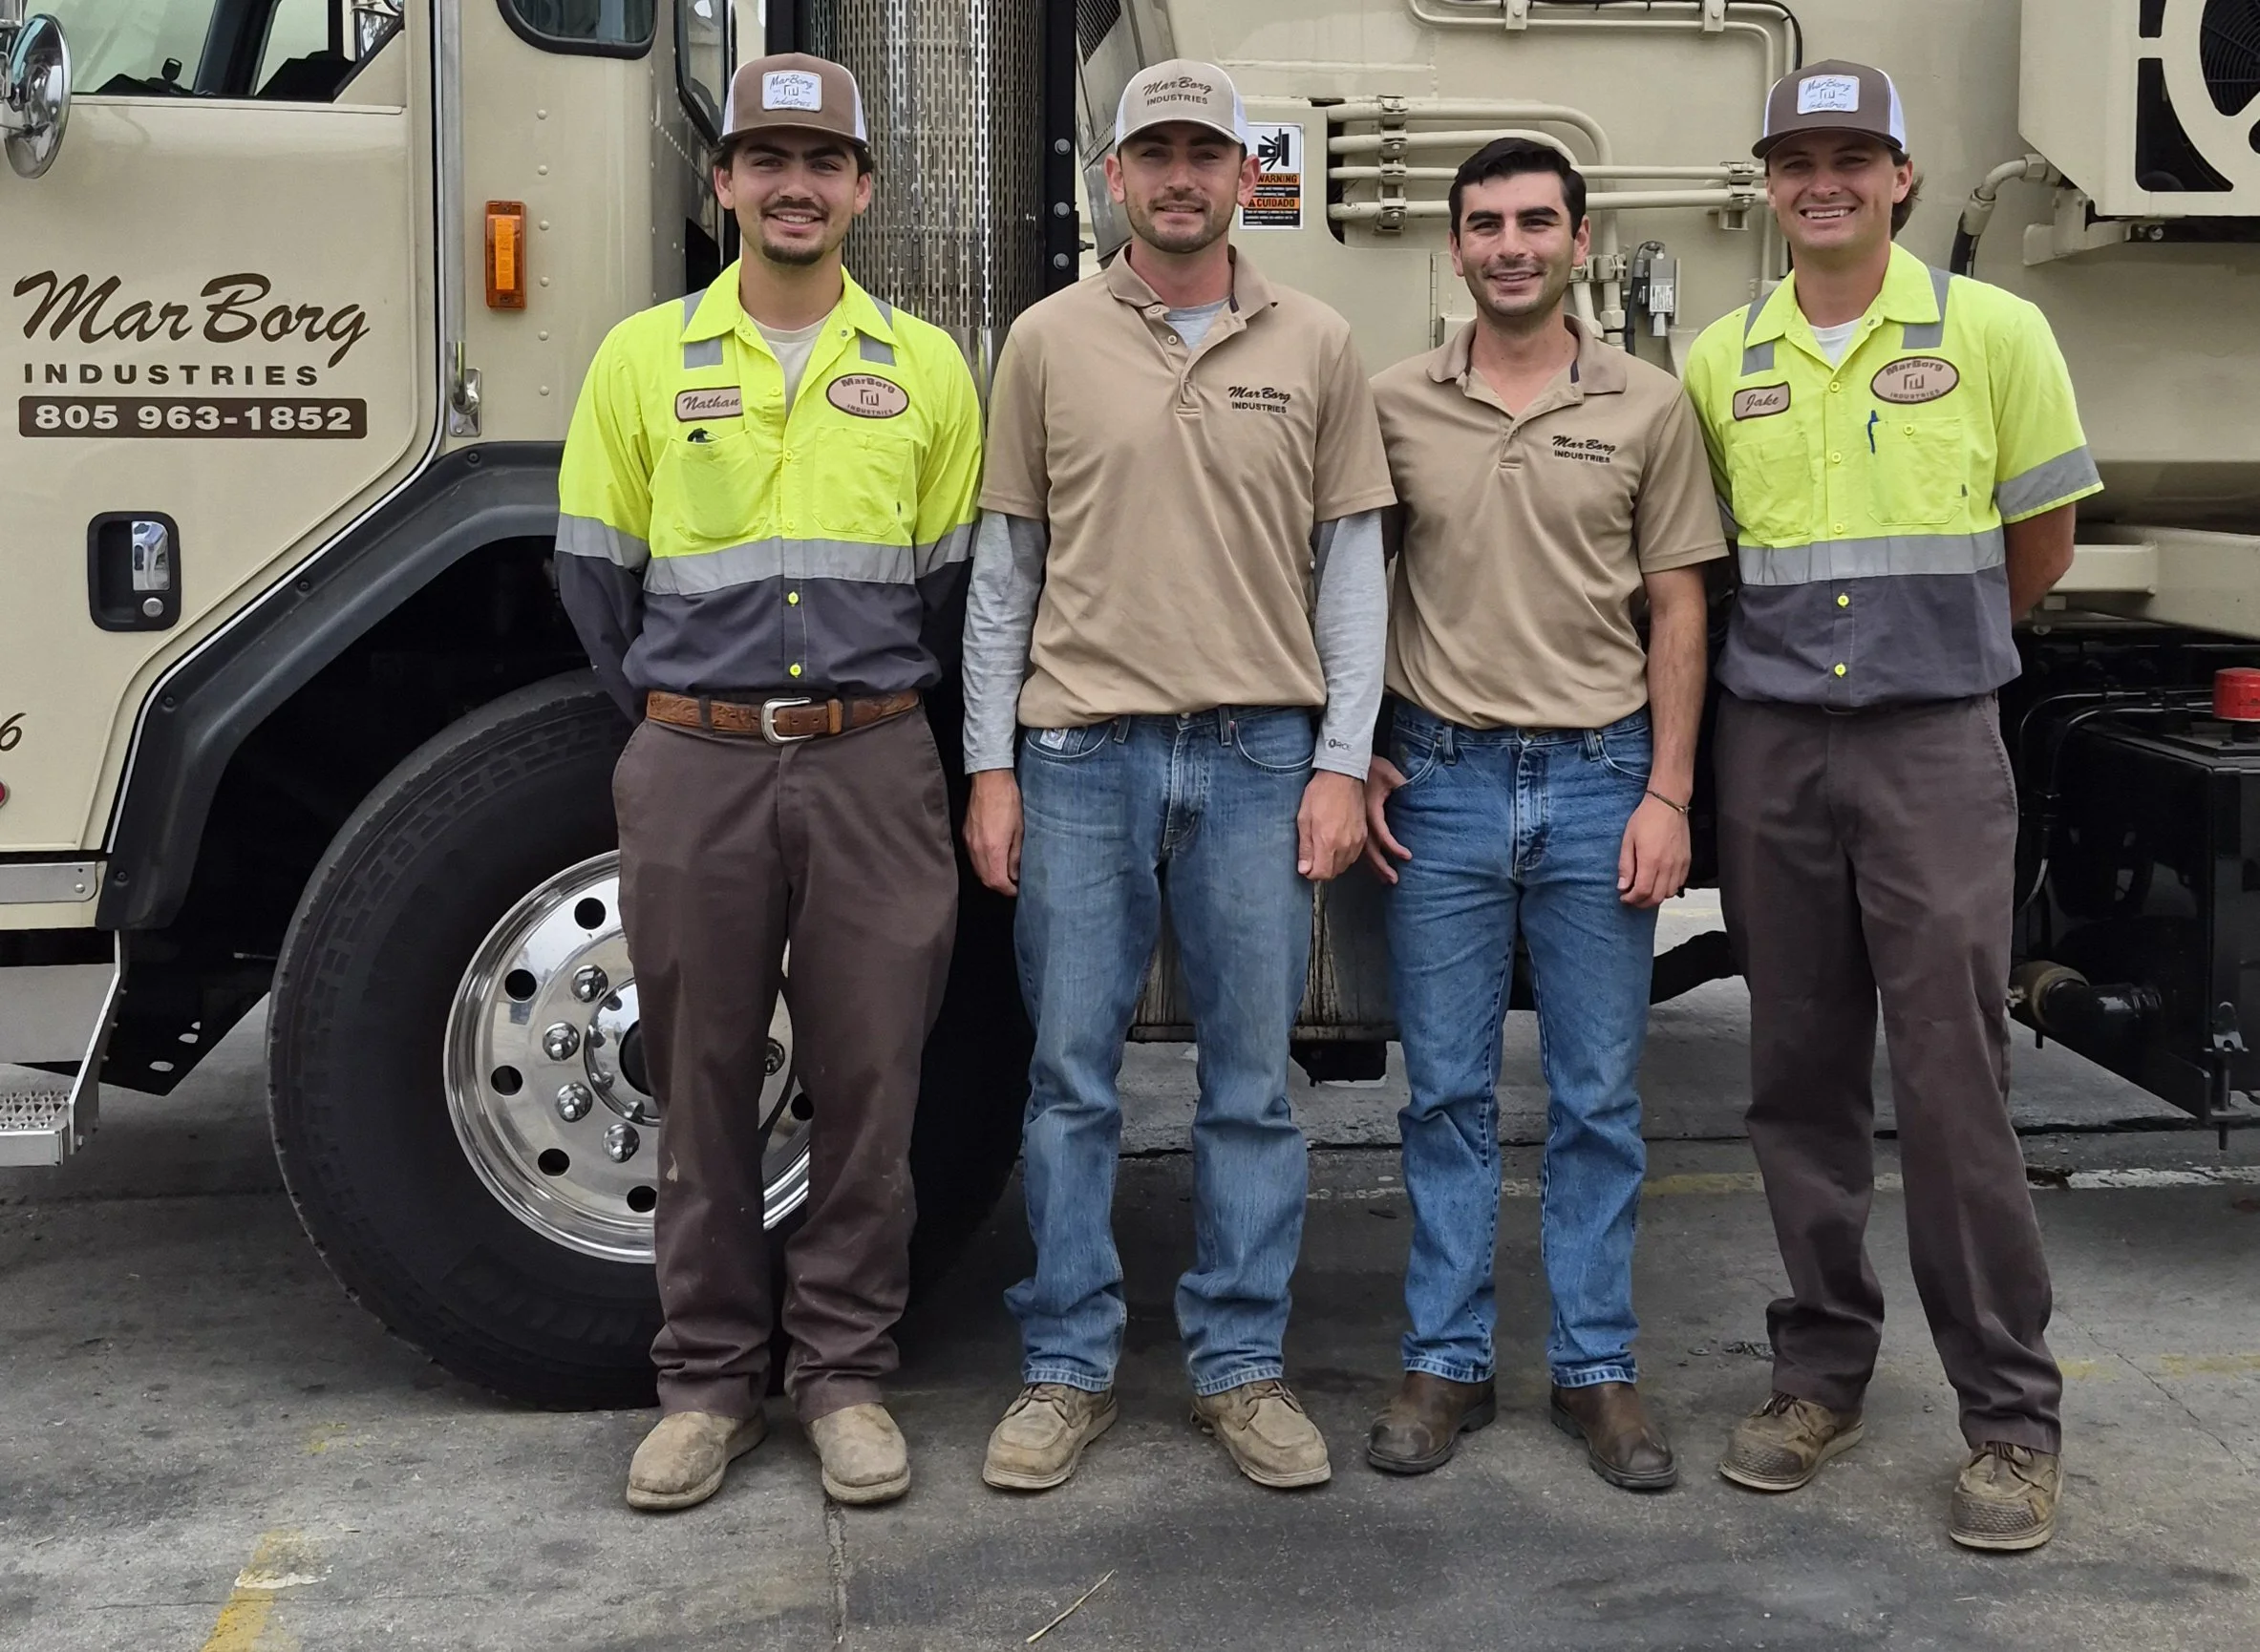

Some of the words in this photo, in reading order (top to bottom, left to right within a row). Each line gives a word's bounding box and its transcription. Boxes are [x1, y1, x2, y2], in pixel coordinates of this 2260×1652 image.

[1147, 94, 1207, 107] INDUSTRIES
[1256, 199, 1295, 207] CUIDADO
[24, 363, 318, 386] INDUSTRIES
[1886, 360, 1944, 375] MarBorg
[841, 377, 896, 393] MarBorg
[1890, 389, 1940, 399] INDUSTRIES
[682, 395, 740, 411] Nathan
[847, 404, 893, 415] INDUSTRIES
[1232, 401, 1287, 413] INDUSTRIES
[1745, 393, 1779, 412] Jake
[34, 404, 118, 430] 805
[138, 405, 352, 431] 963-1852
[1554, 450, 1610, 463] INDUSTRIES
